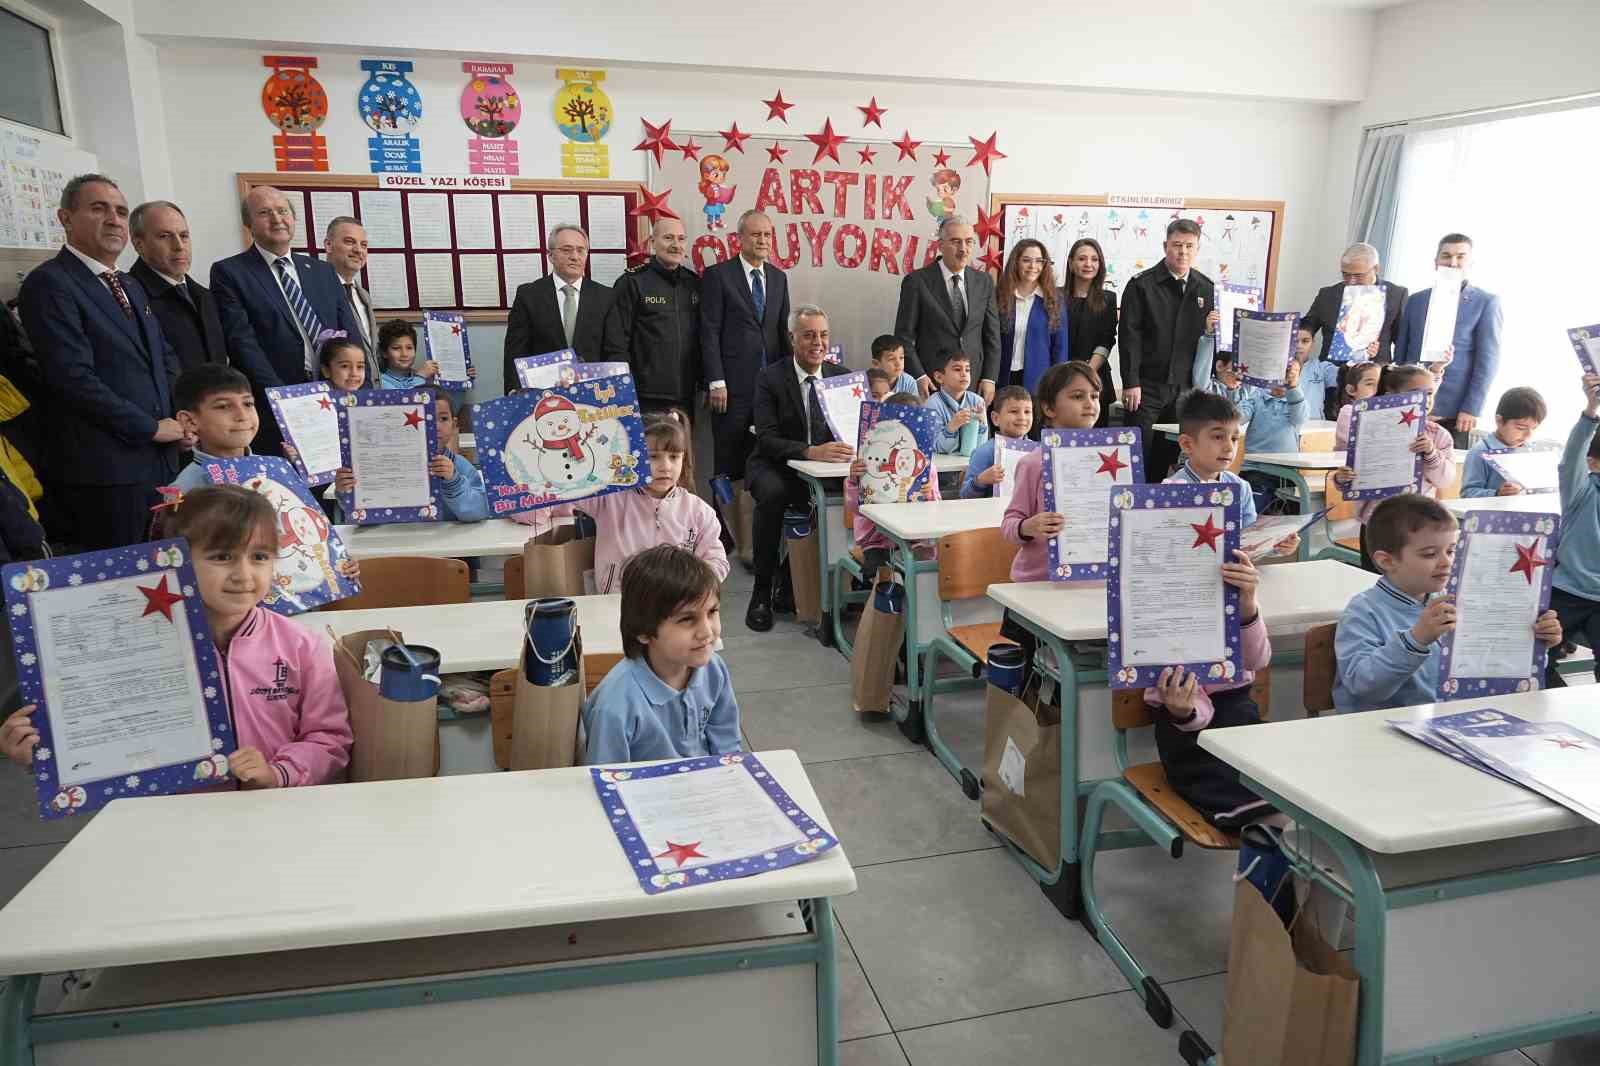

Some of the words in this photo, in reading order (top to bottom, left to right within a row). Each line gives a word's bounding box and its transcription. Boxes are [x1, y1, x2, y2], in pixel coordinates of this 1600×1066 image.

[387, 176, 425, 186] GÜZEL
[431, 177, 457, 186] YAZI
[463, 177, 505, 188] KÖŞESİ
[754, 167, 915, 221] ARTIK
